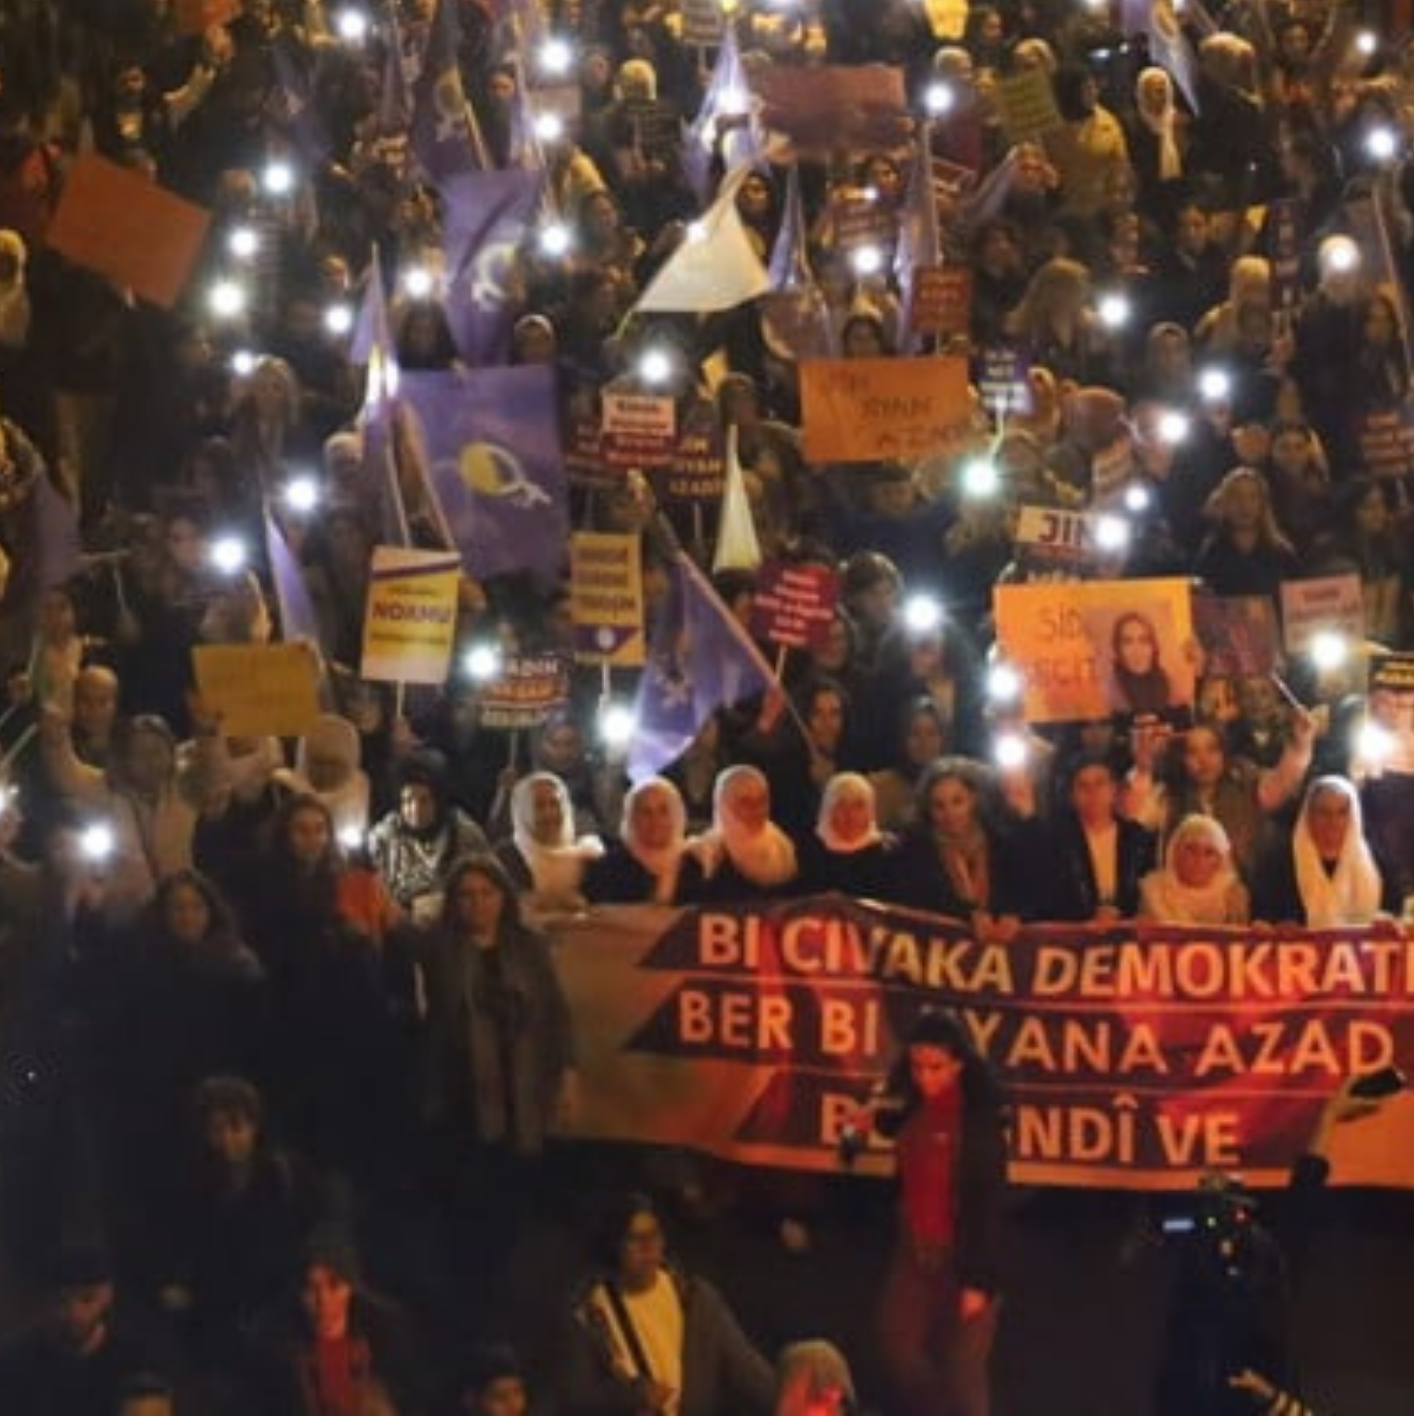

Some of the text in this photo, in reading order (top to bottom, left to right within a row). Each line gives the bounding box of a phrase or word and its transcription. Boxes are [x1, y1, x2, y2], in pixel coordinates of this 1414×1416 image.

[699, 912, 761, 969] BI
[678, 990, 793, 1051] BER
[821, 999, 878, 1057] BI
[920, 1004, 1167, 1074] YANA
[1195, 1018, 1394, 1076] AZAD
[1155, 1114, 1241, 1165] VE
